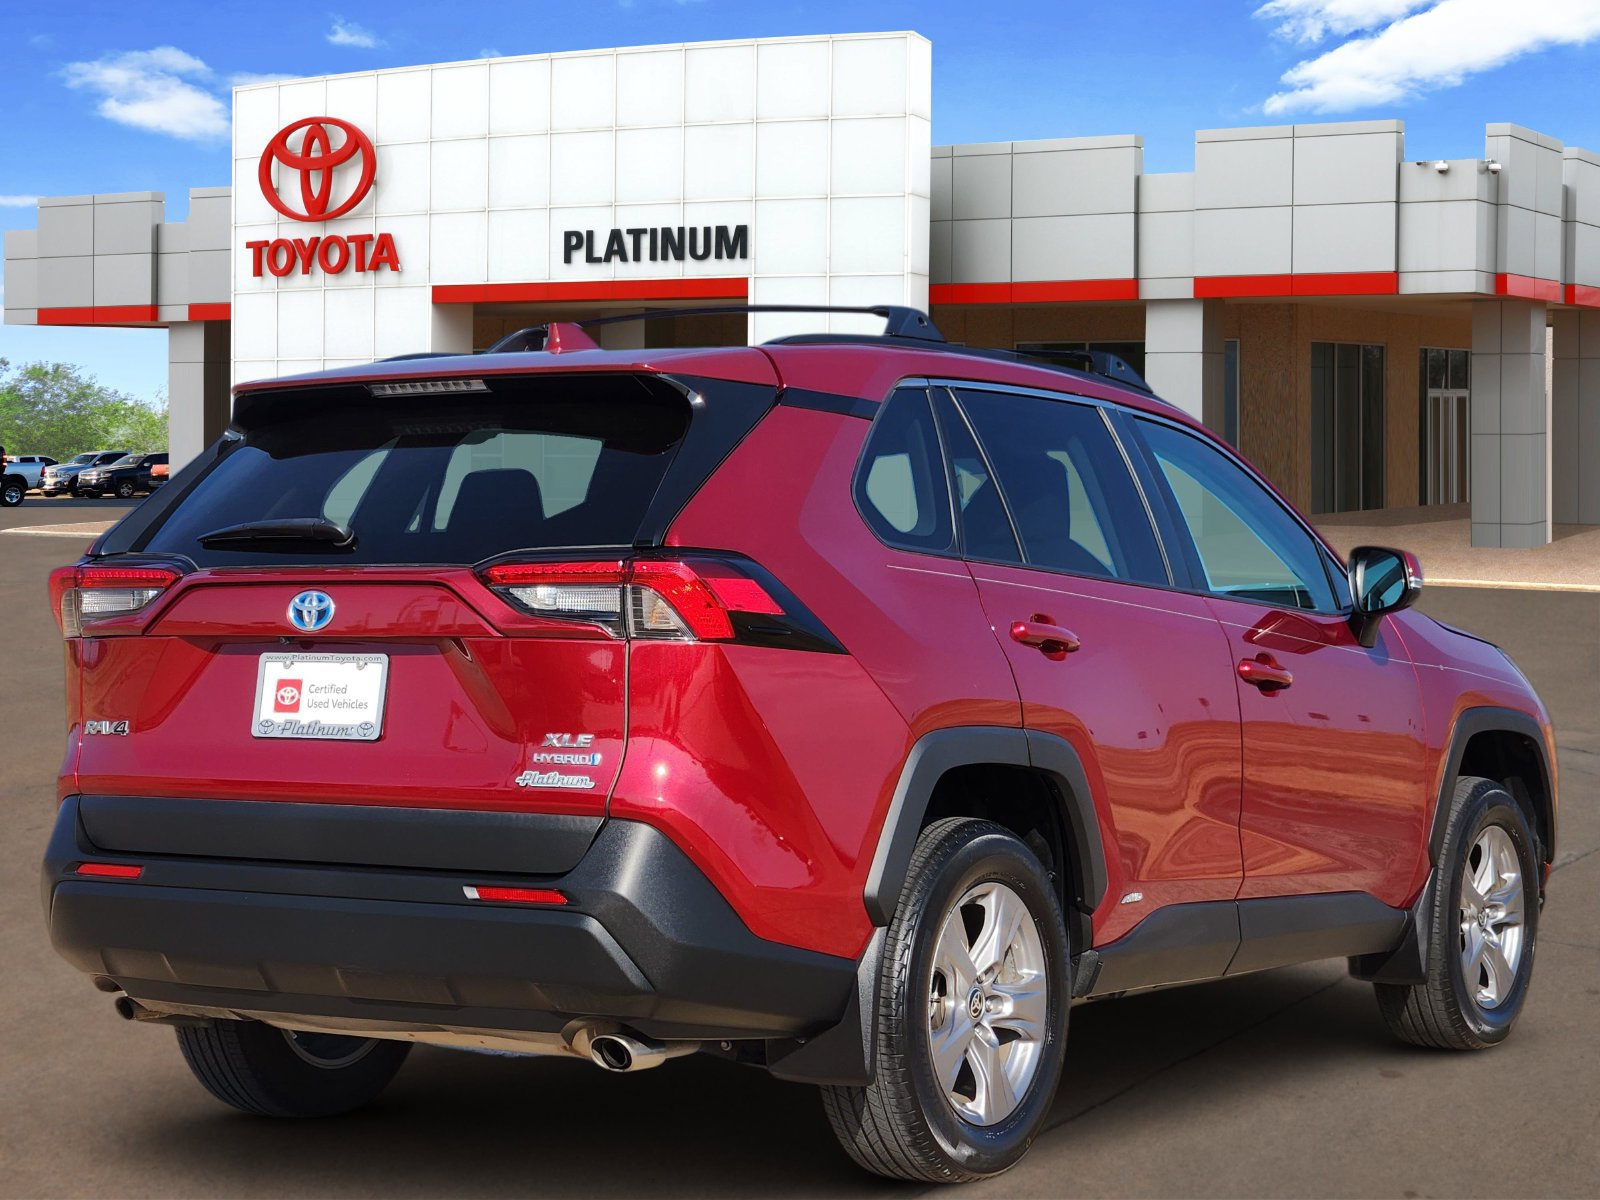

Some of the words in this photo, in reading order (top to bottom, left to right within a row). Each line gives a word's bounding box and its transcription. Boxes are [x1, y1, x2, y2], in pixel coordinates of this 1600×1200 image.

[563, 225, 748, 264] PLATINUM
[245, 233, 401, 277] TOYOTA
[266, 654, 382, 662] www.PlatinumToyota.com
[308, 684, 348, 695] Certified
[307, 699, 329, 709] Used
[332, 699, 368, 710] Vehicles
[84, 720, 129, 736] RAV4
[280, 720, 352, 737] Platinum
[541, 733, 595, 747] XLE
[533, 753, 591, 765] HYBRID
[515, 770, 596, 788] Platinum
